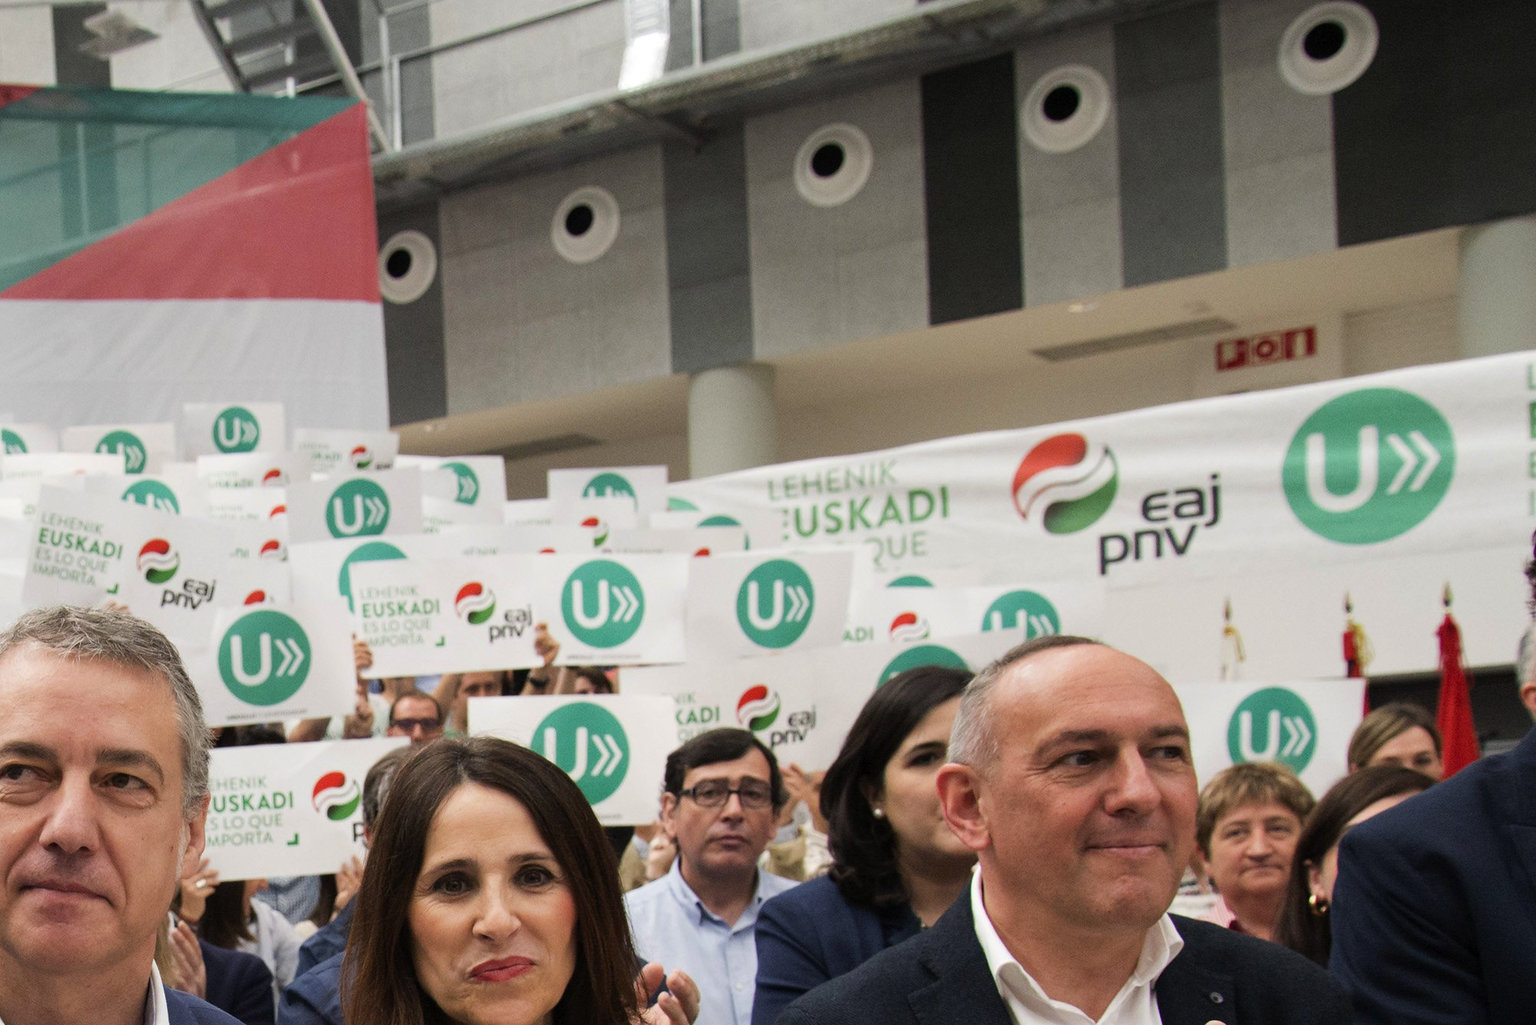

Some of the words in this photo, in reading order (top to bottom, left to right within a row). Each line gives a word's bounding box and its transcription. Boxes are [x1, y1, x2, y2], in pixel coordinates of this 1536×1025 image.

[768, 459, 898, 501] LEHENIK
[1141, 474, 1222, 527] eaj
[41, 511, 104, 536] LEHENIK
[783, 484, 950, 542] USKADI
[38, 527, 123, 560] EUSKADI
[1099, 525, 1197, 575] pnv
[161, 589, 209, 610] pnv
[183, 579, 216, 602] eaj
[362, 599, 440, 618] EUSKADI
[209, 776, 267, 790] EHENIK
[210, 790, 293, 813] USKADI
[207, 831, 273, 847] MPORTA
